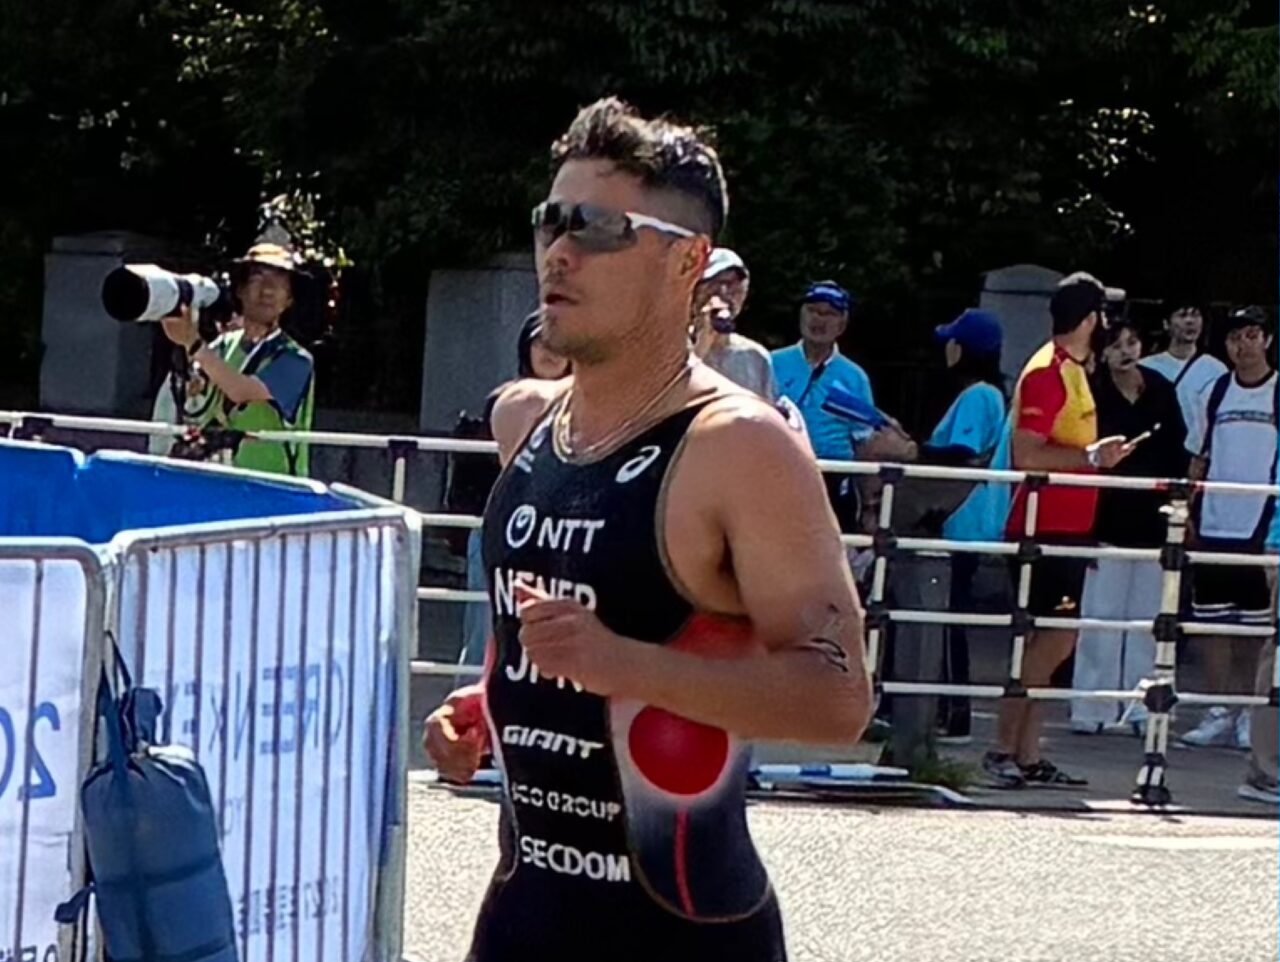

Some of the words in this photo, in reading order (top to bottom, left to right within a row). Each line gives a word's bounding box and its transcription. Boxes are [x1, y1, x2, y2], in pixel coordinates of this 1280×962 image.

[537, 517, 605, 553] NTT
[502, 725, 604, 759] GIANT
[547, 791, 622, 822] GROUP
[520, 835, 631, 882] SECDOM
